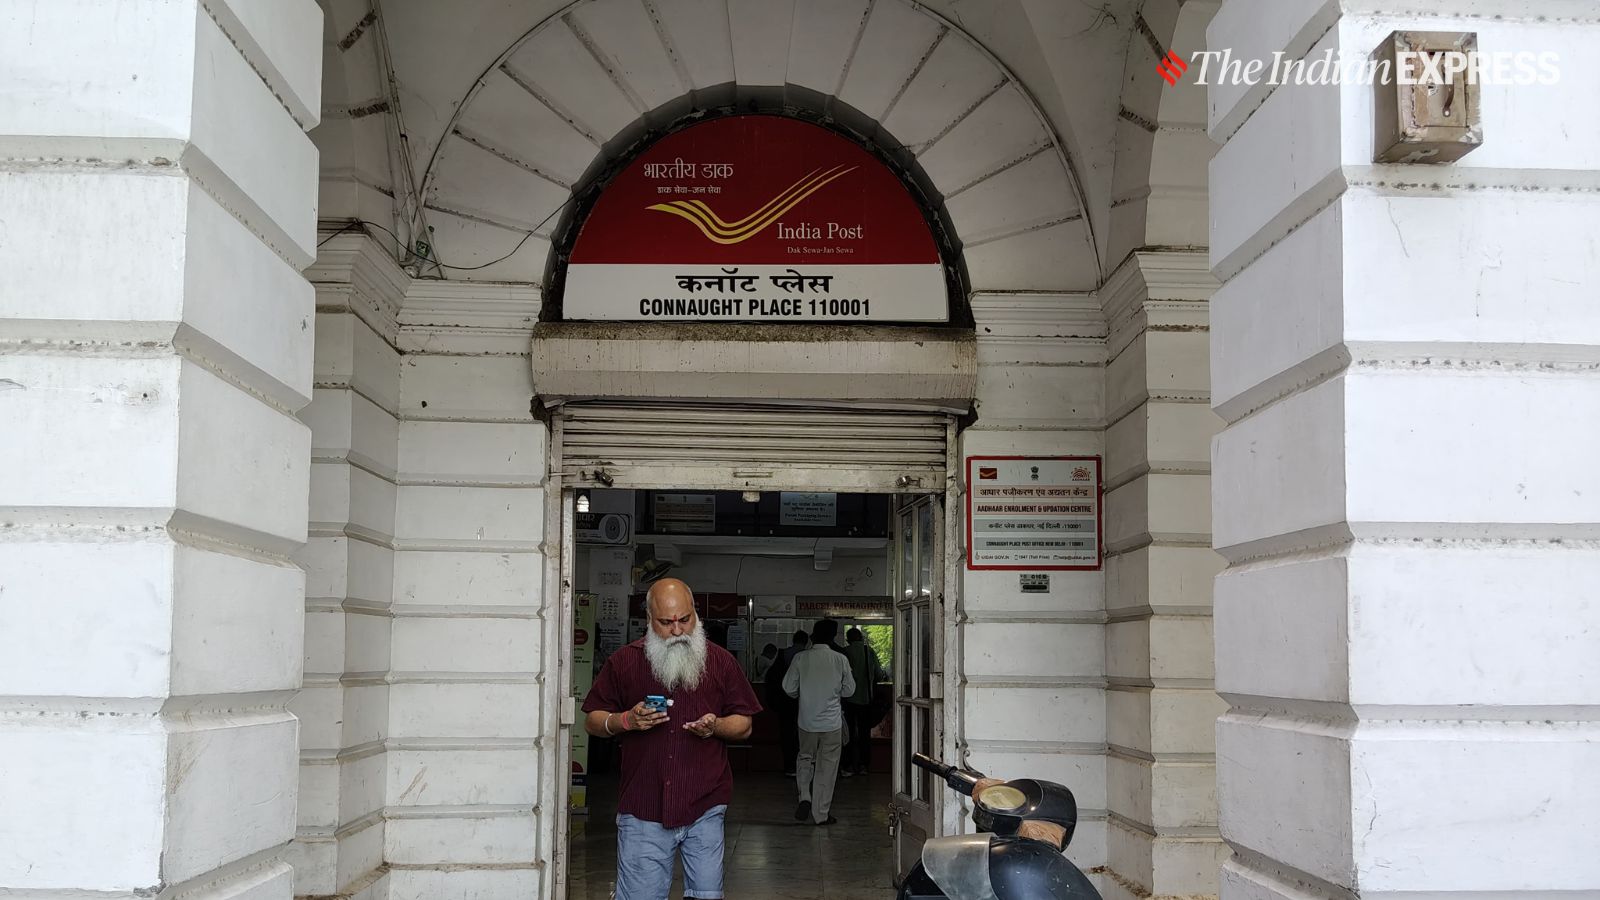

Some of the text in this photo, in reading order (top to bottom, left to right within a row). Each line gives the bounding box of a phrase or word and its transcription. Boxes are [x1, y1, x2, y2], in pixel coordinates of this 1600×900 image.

[644, 157, 734, 179] भारतीय डाक
[657, 186, 672, 194] डाक
[707, 185, 721, 194] सेवा
[777, 222, 864, 240] India Post
[787, 246, 854, 254] Dak Sewa-Jan Sewa
[675, 268, 833, 293] कनॉट प्लेस
[639, 298, 870, 316] CONNAUGHT PLACE 110001
[980, 488, 1000, 496] आधार
